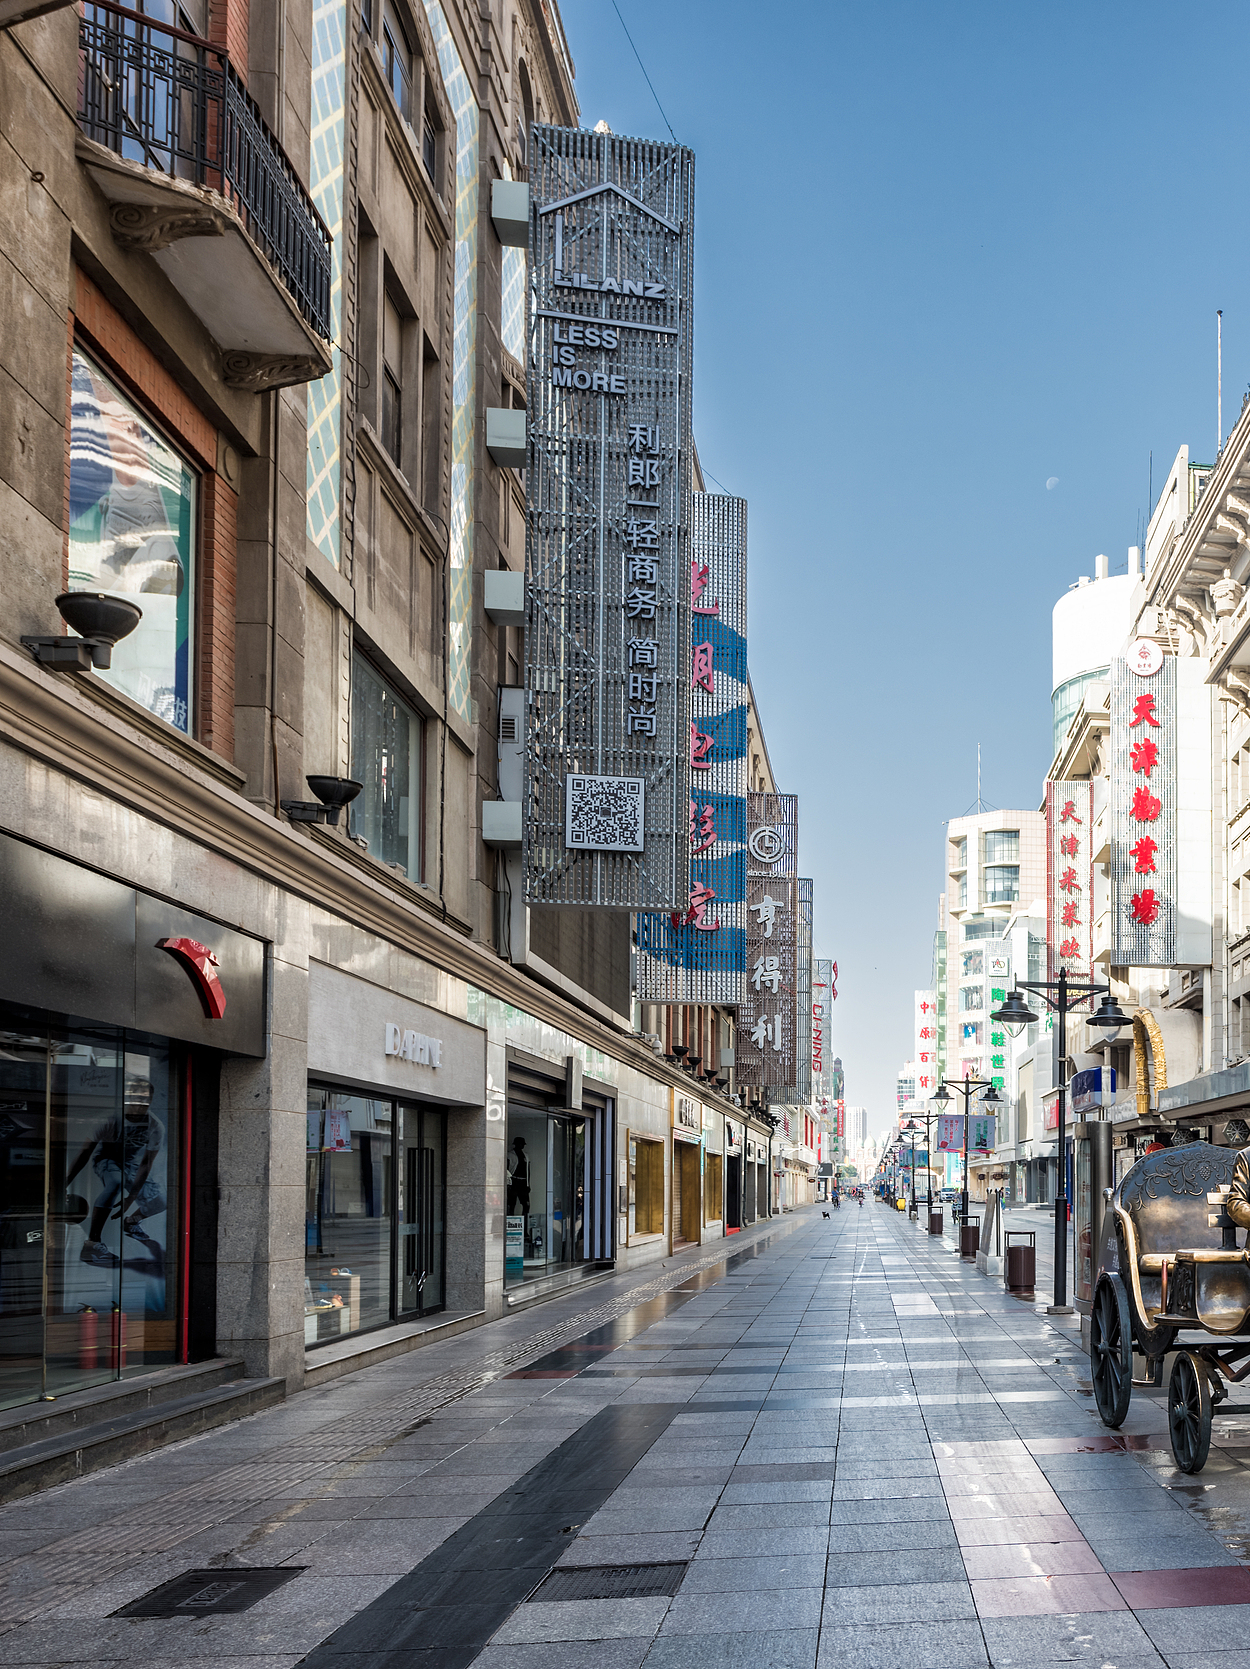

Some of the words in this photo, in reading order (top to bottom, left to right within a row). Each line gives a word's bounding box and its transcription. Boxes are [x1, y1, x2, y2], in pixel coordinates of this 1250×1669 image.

[554, 269, 665, 300] LILANZ
[553, 345, 576, 367] IS
[554, 323, 618, 350] LESS
[552, 368, 626, 395] MORE
[627, 635, 661, 738] 简时尚
[750, 895, 784, 1052] 亨得利
[812, 1003, 823, 1073] LI-NING
[990, 987, 1006, 1091] 陶鞋世界
